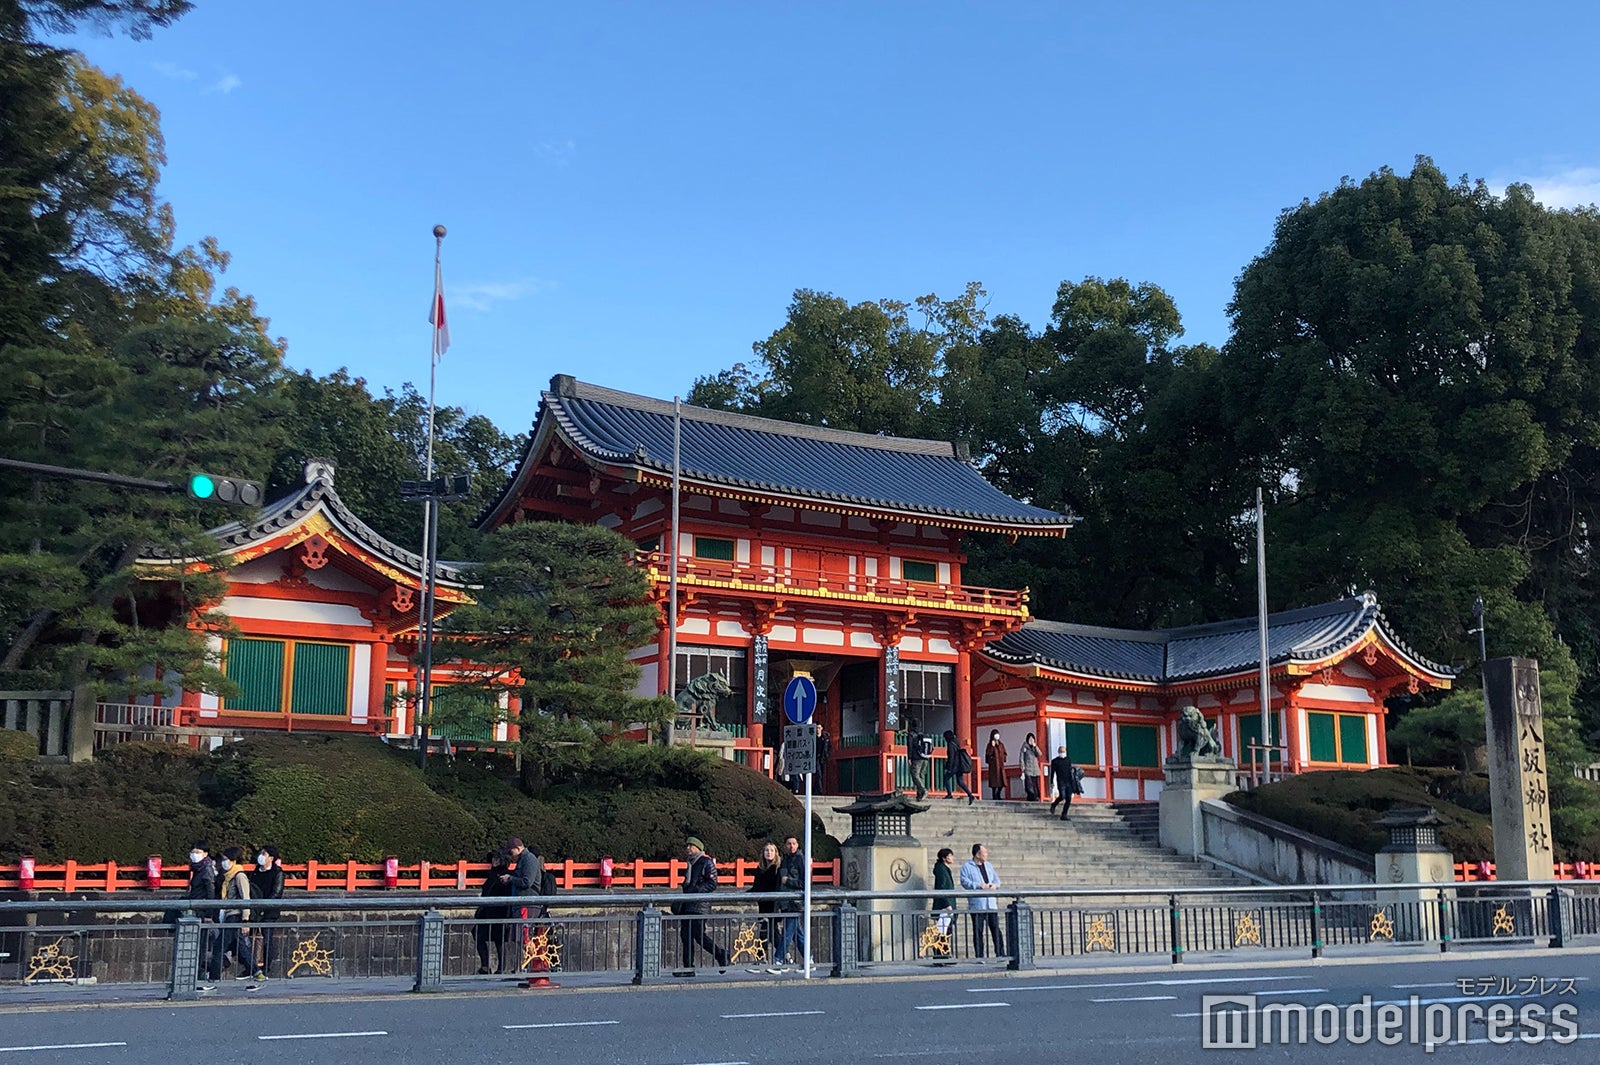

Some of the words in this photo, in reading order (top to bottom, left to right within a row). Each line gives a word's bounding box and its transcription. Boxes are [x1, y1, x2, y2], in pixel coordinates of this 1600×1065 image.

[755, 669, 766, 716] 月次祭
[887, 680, 898, 725] 天長祭
[1520, 724, 1549, 854] 八坂神社
